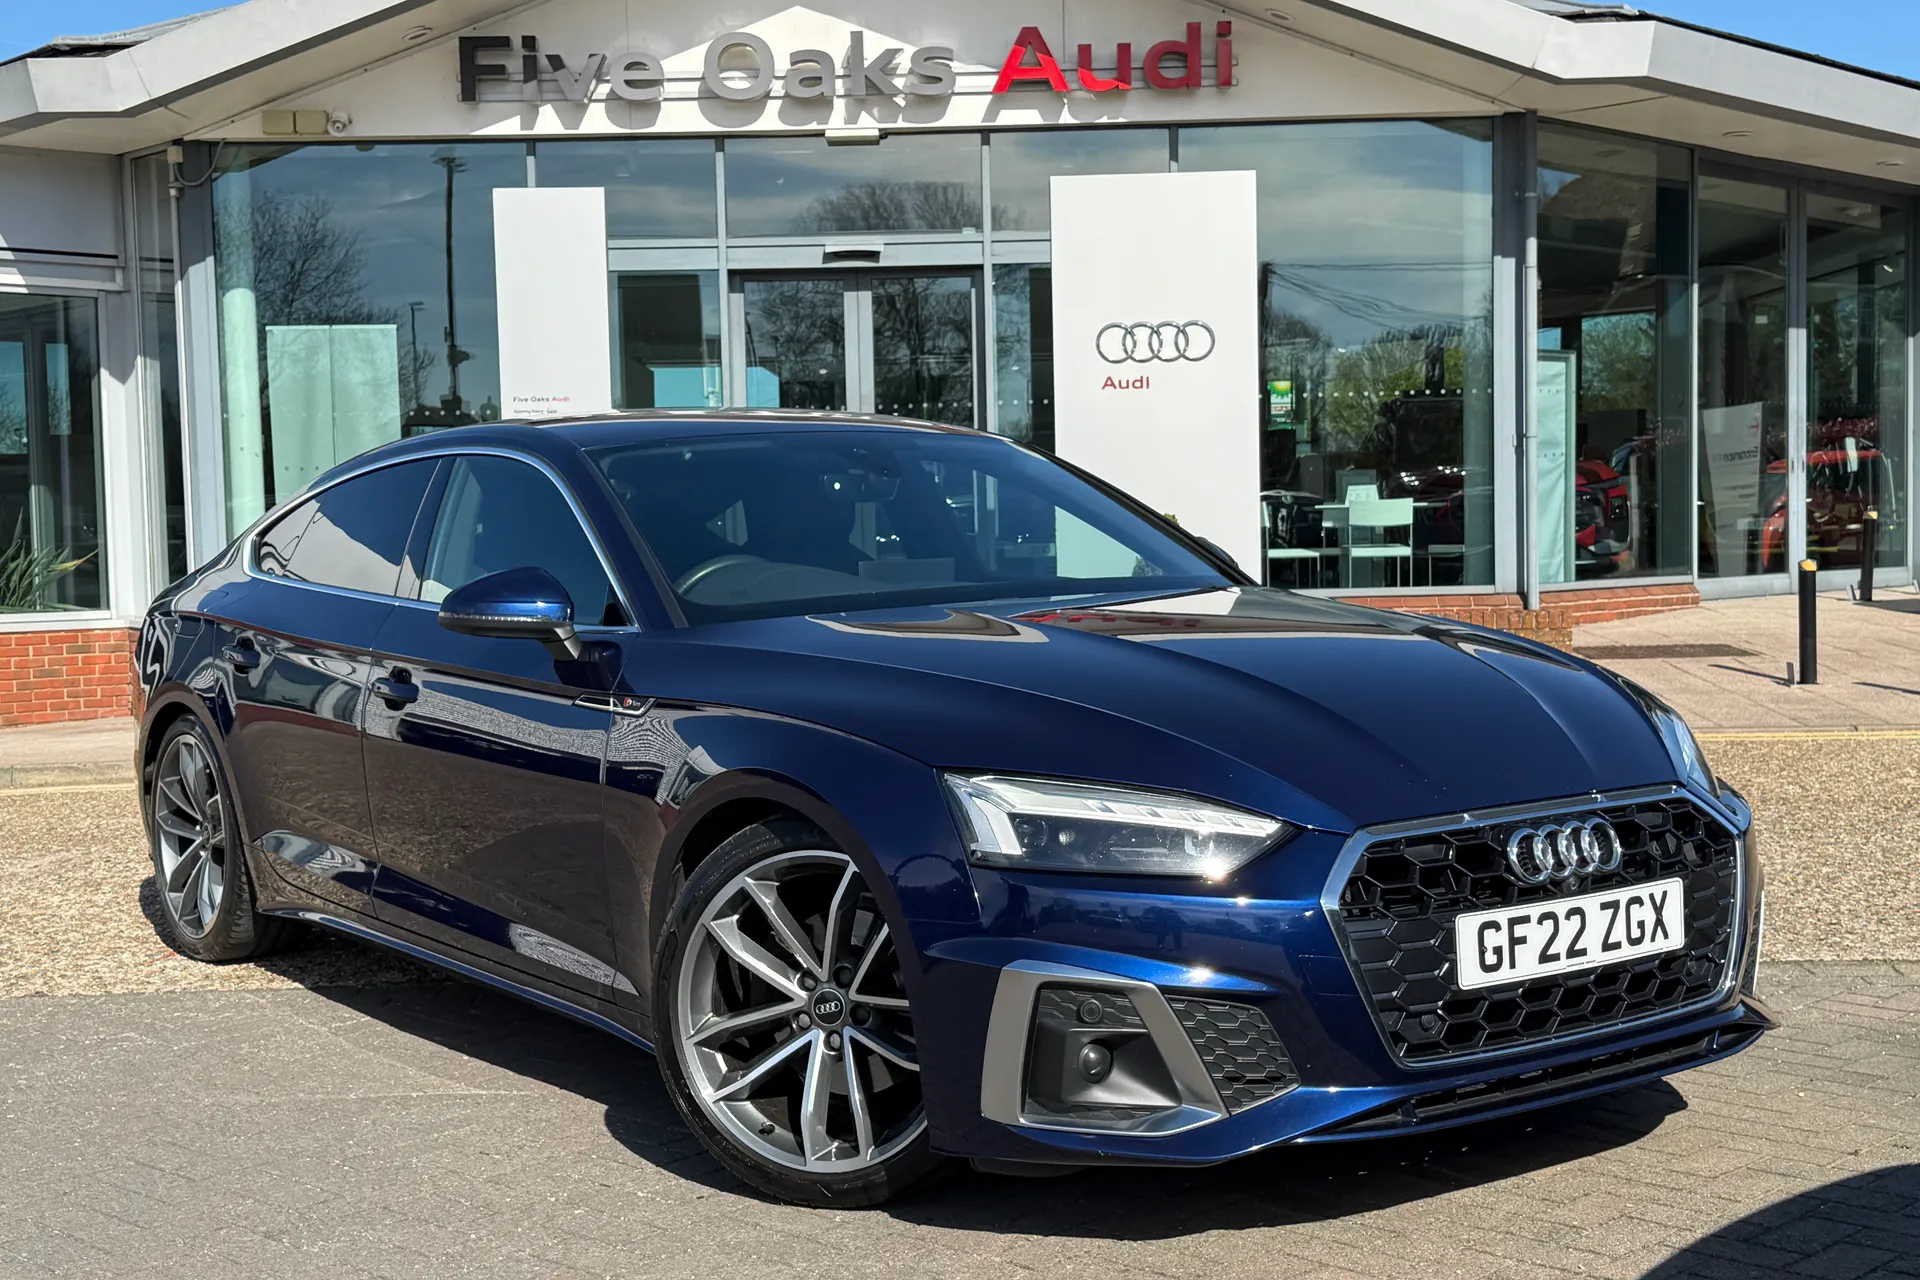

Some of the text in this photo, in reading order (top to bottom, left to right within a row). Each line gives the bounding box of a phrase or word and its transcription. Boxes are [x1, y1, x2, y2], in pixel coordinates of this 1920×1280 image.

[459, 21, 1233, 103] Five Oaks Audi
[1101, 375, 1150, 390] Audi
[1477, 890, 1670, 973] GF22 ZGX
